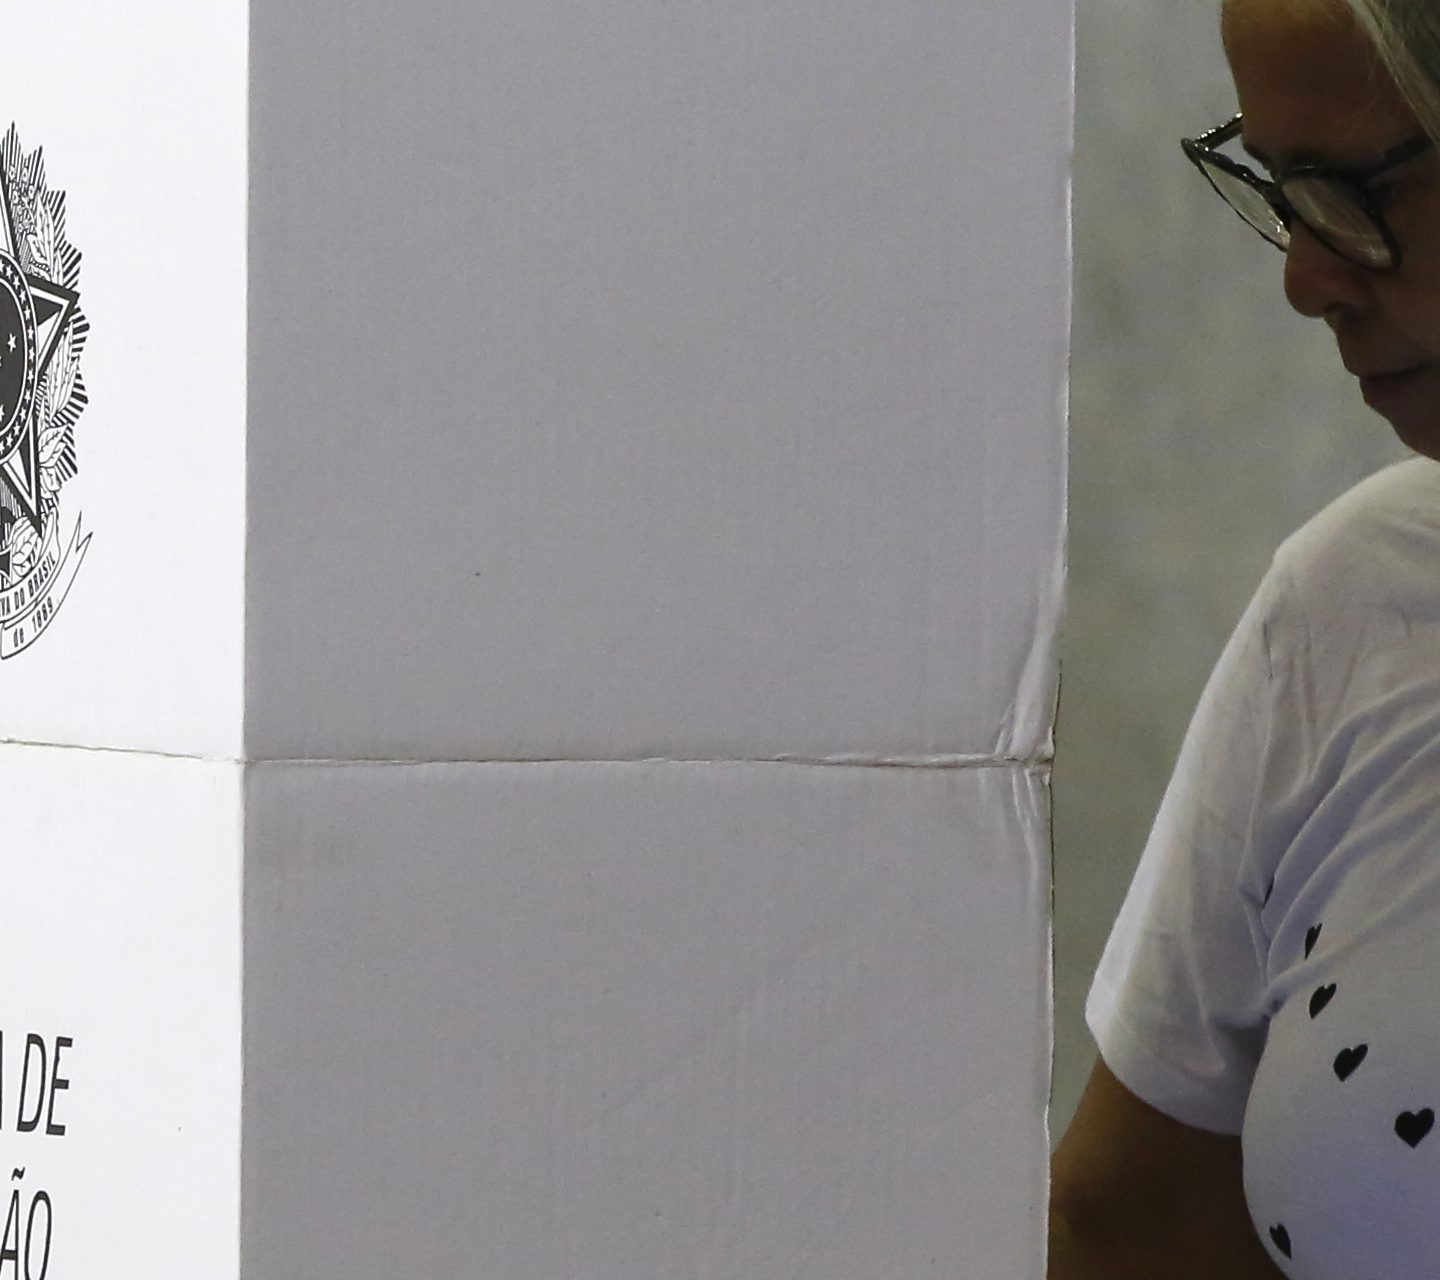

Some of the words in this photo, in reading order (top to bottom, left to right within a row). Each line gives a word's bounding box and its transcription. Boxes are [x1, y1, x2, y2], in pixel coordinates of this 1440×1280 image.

[14, 587, 26, 611] DO
[27, 551, 56, 598] BRASIL
[13, 627, 24, 648] de
[31, 596, 54, 633] 1889
[16, 1033, 73, 1136] DE
